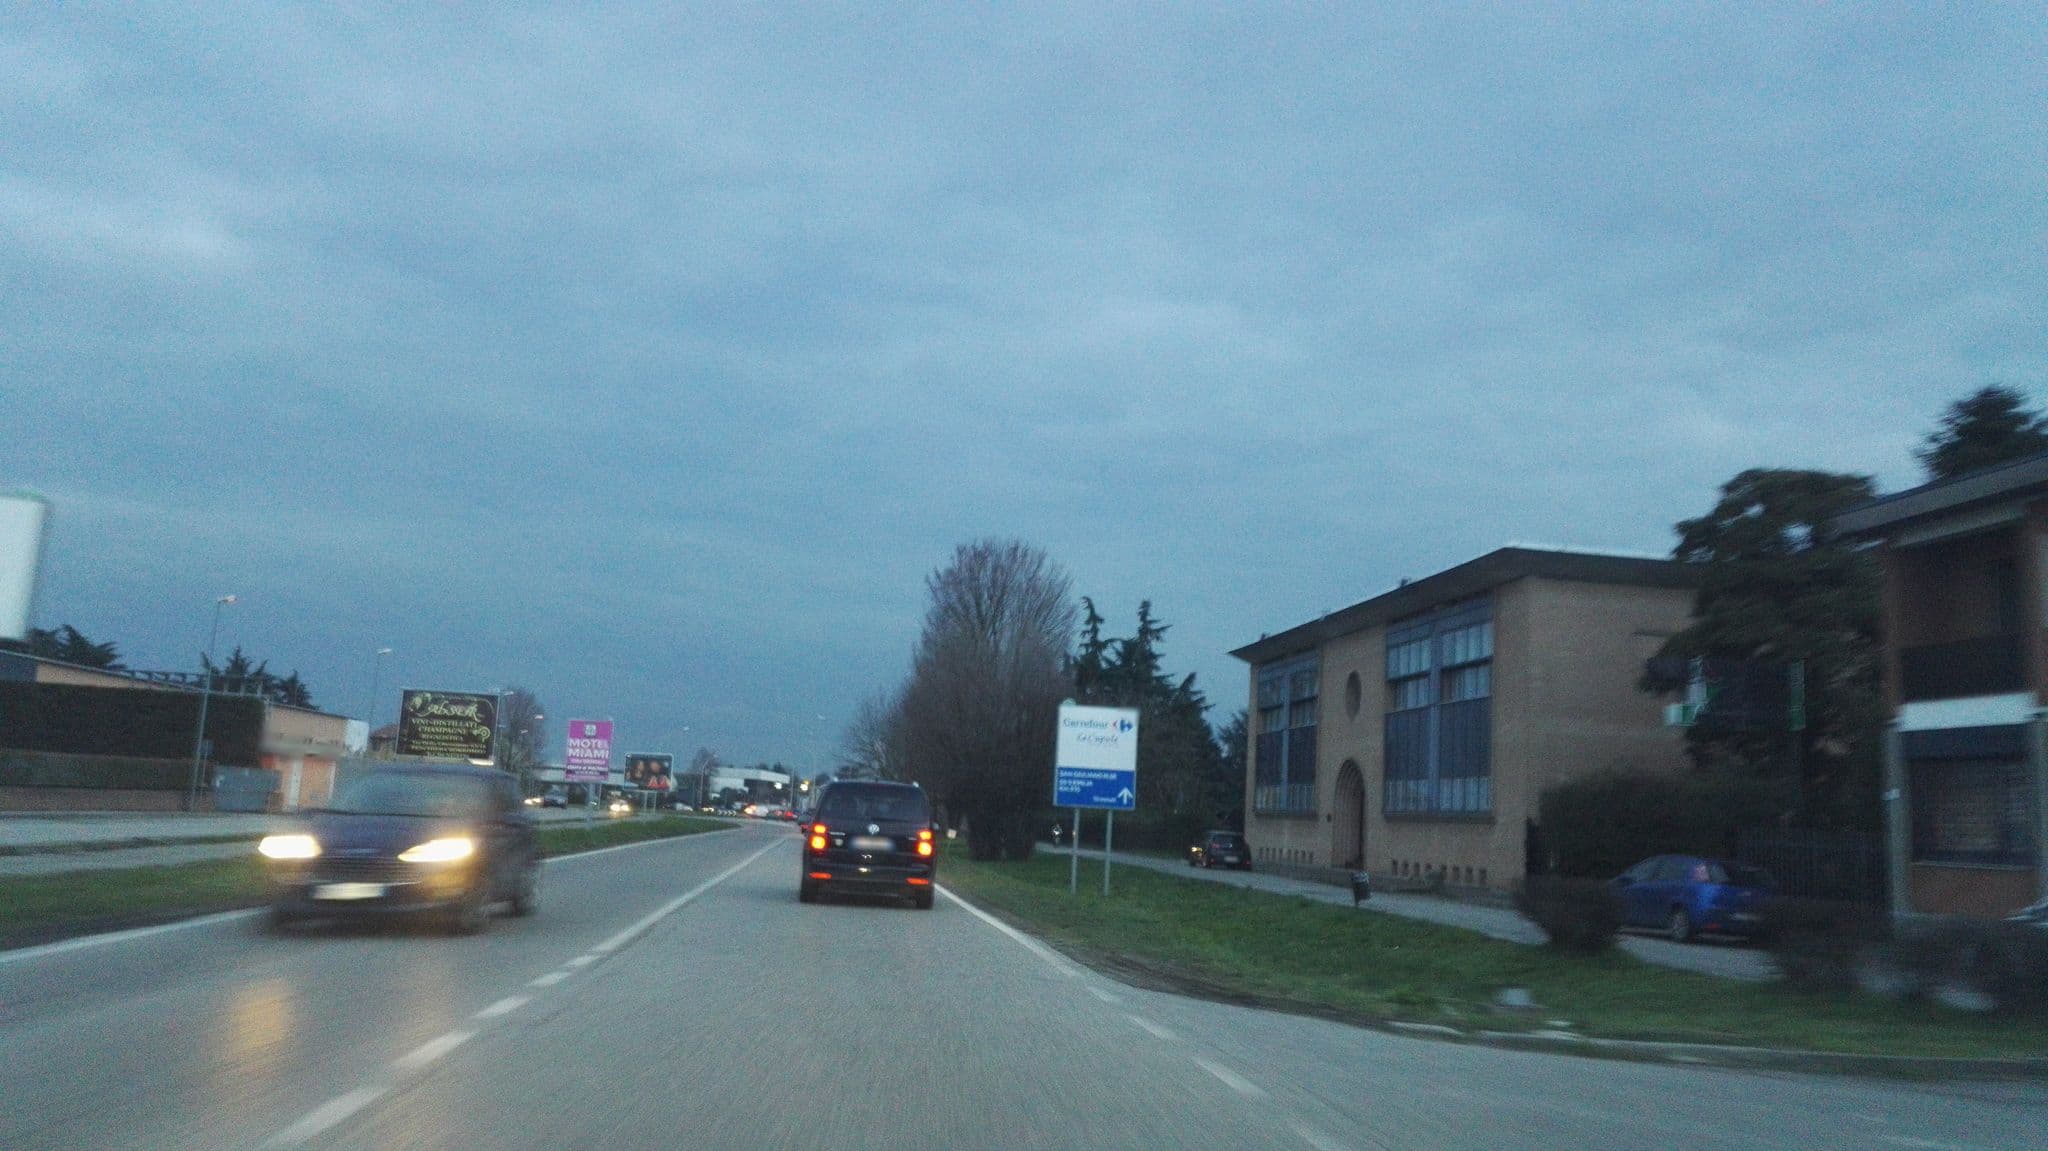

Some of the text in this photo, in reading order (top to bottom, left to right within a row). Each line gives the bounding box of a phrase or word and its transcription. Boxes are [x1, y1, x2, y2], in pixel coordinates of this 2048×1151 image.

[1063, 718, 1108, 729] Carrefour
[569, 739, 609, 749] MOTEL
[568, 749, 609, 759] MIAMI
